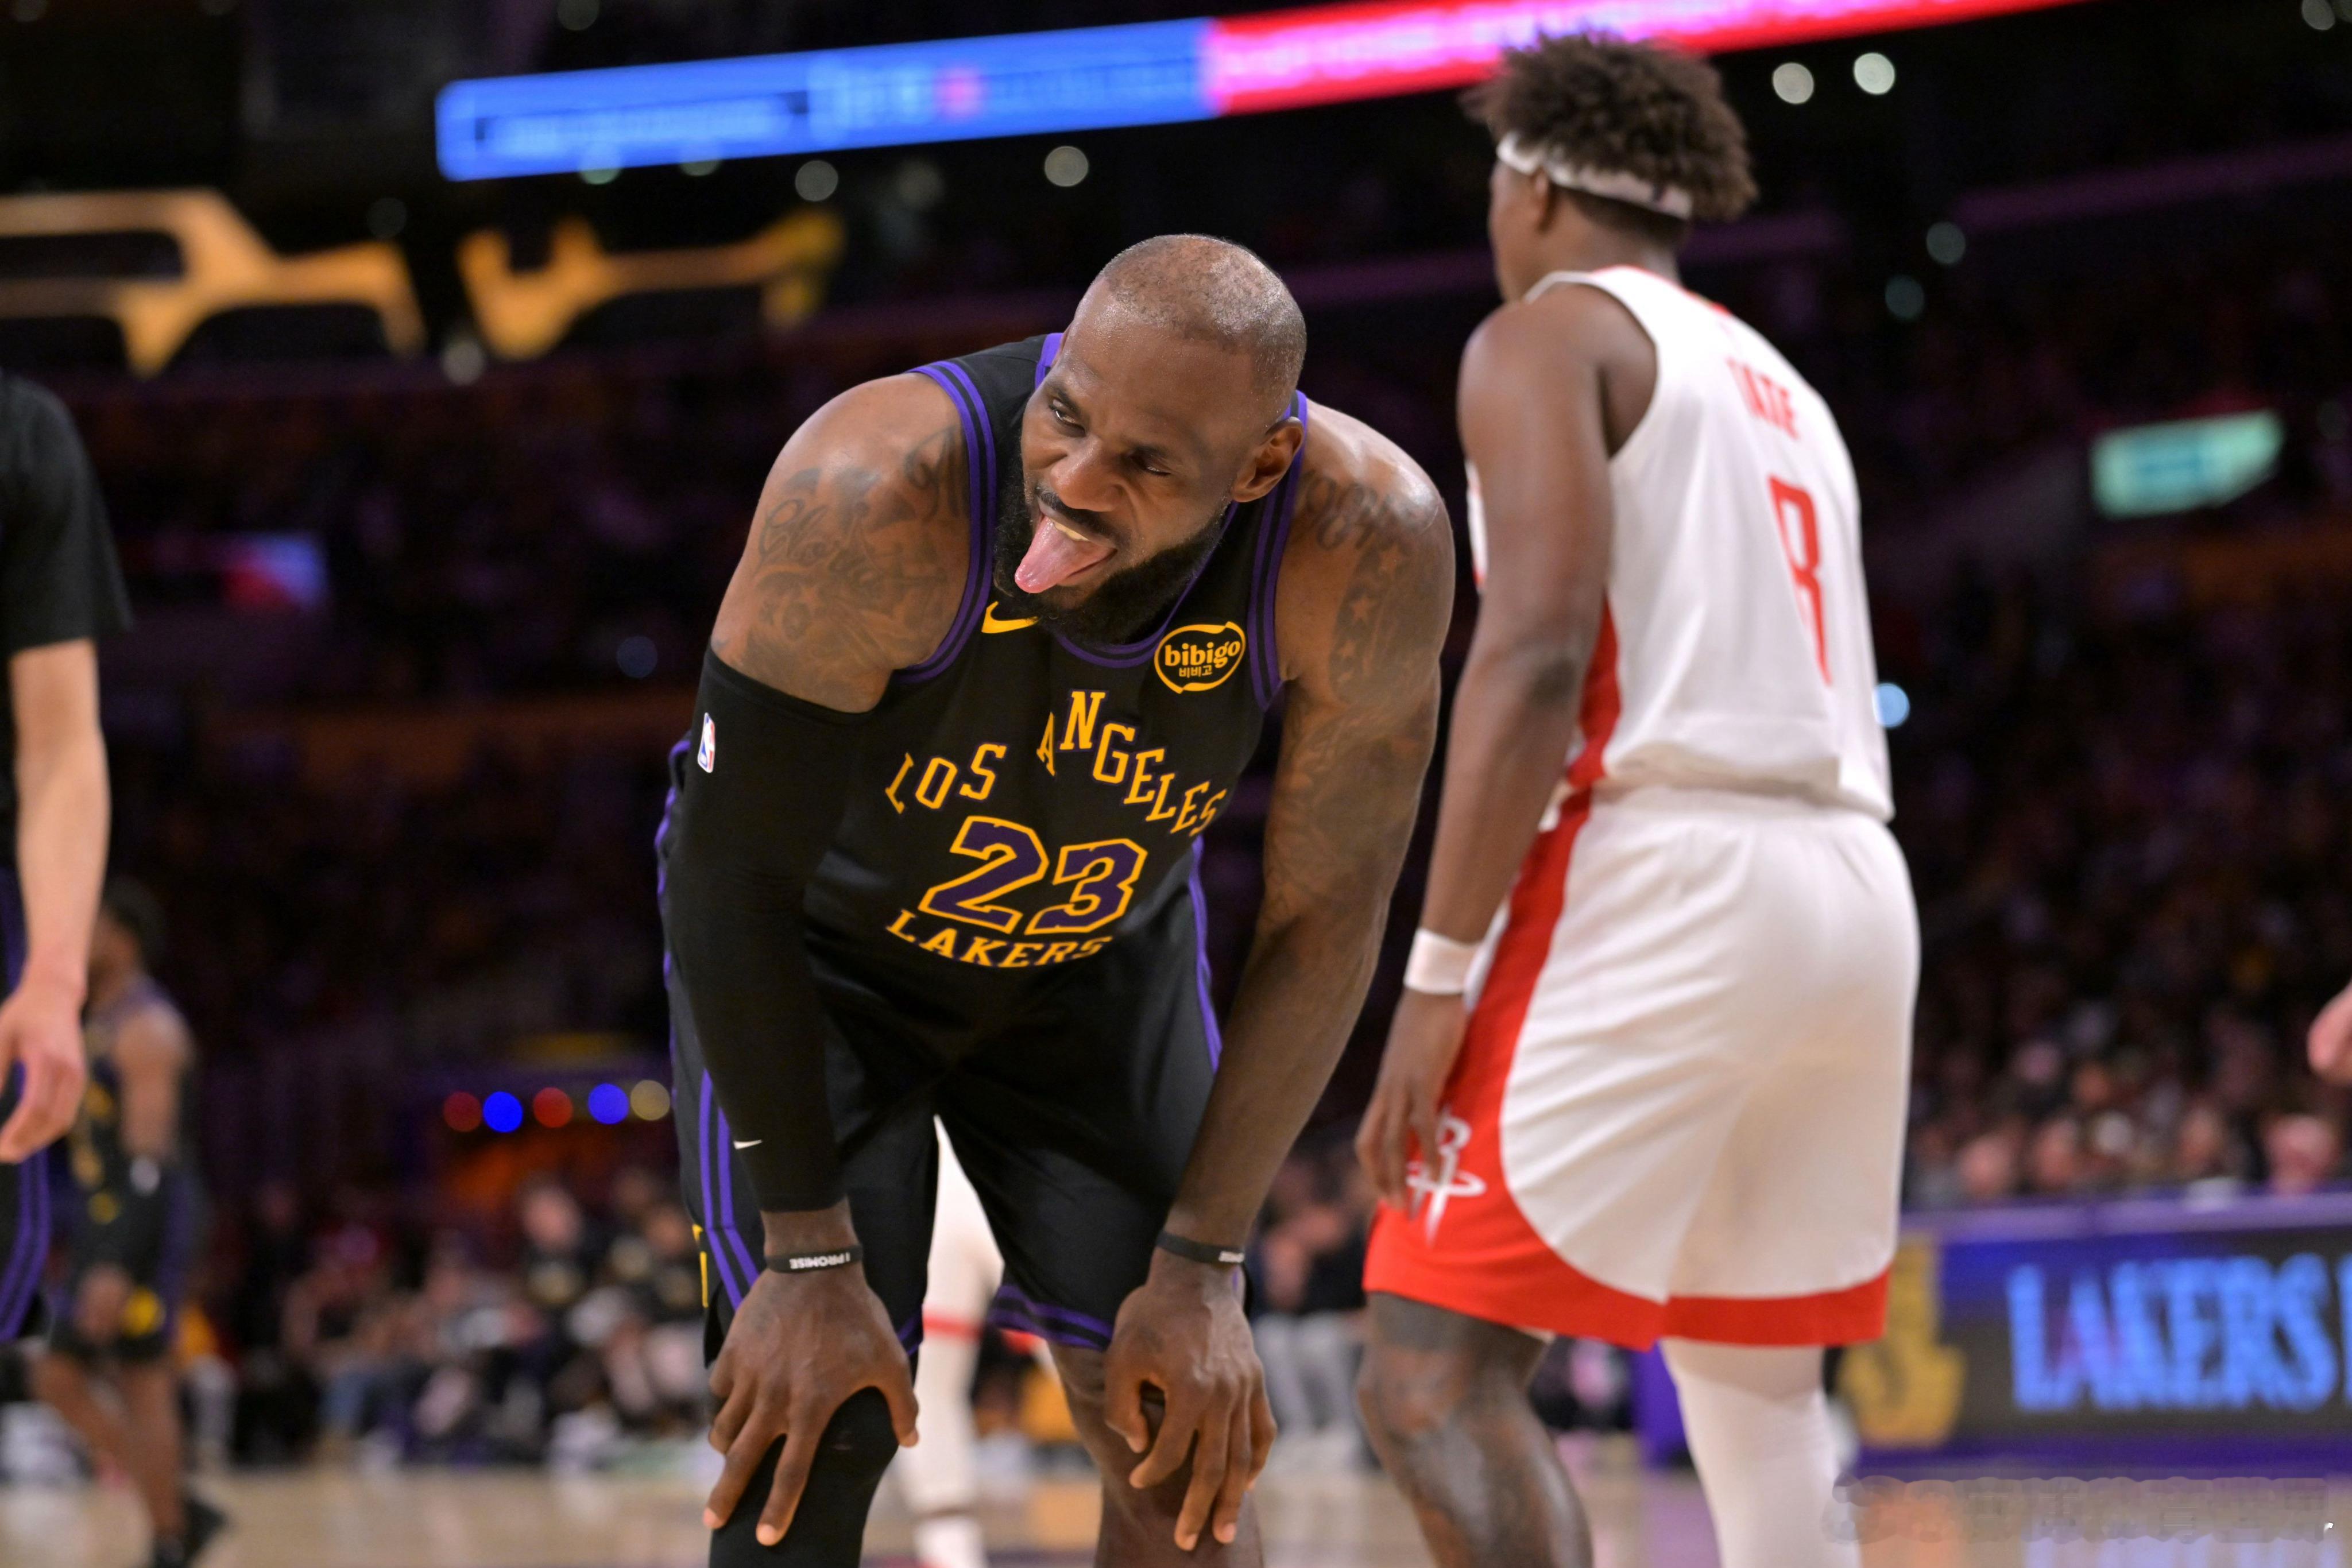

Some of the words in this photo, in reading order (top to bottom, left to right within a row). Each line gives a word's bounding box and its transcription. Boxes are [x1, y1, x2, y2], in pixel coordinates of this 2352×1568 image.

[1165, 641, 1241, 668] bibigo
[1178, 664, 1213, 678] 비비고
[885, 743, 1007, 814] LOS
[1036, 690, 1227, 837] ANGELES
[918, 815, 1148, 935] 23
[885, 909, 1113, 968] LAKERS
[2006, 1252, 2338, 1412] LAKERS
